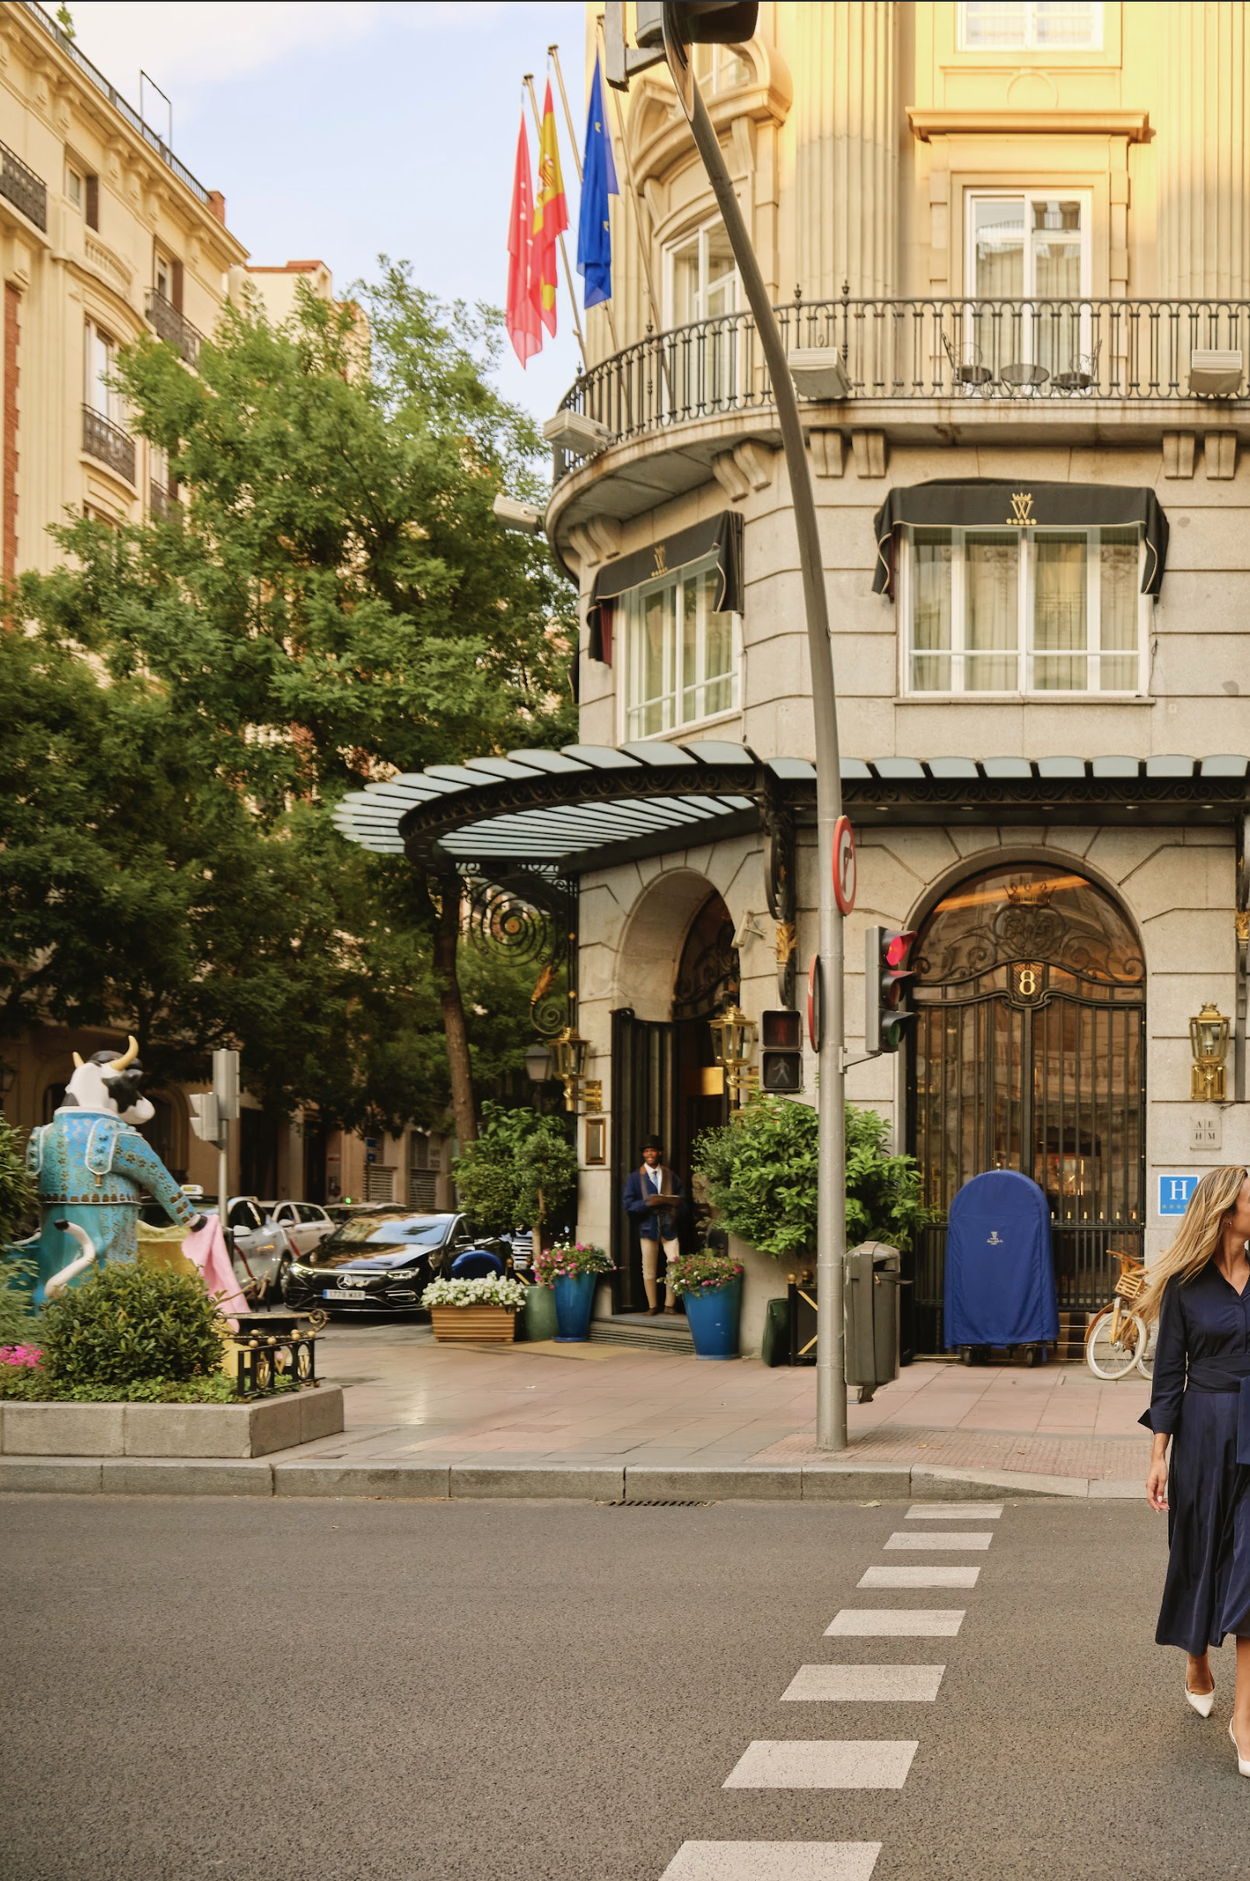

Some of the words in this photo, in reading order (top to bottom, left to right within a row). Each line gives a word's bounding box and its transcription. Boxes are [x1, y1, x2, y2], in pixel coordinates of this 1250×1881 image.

[1019, 970, 1036, 996] 8
[1195, 1132, 1202, 1140] H
[1208, 1132, 1216, 1140] M
[1170, 1180, 1188, 1200] H
